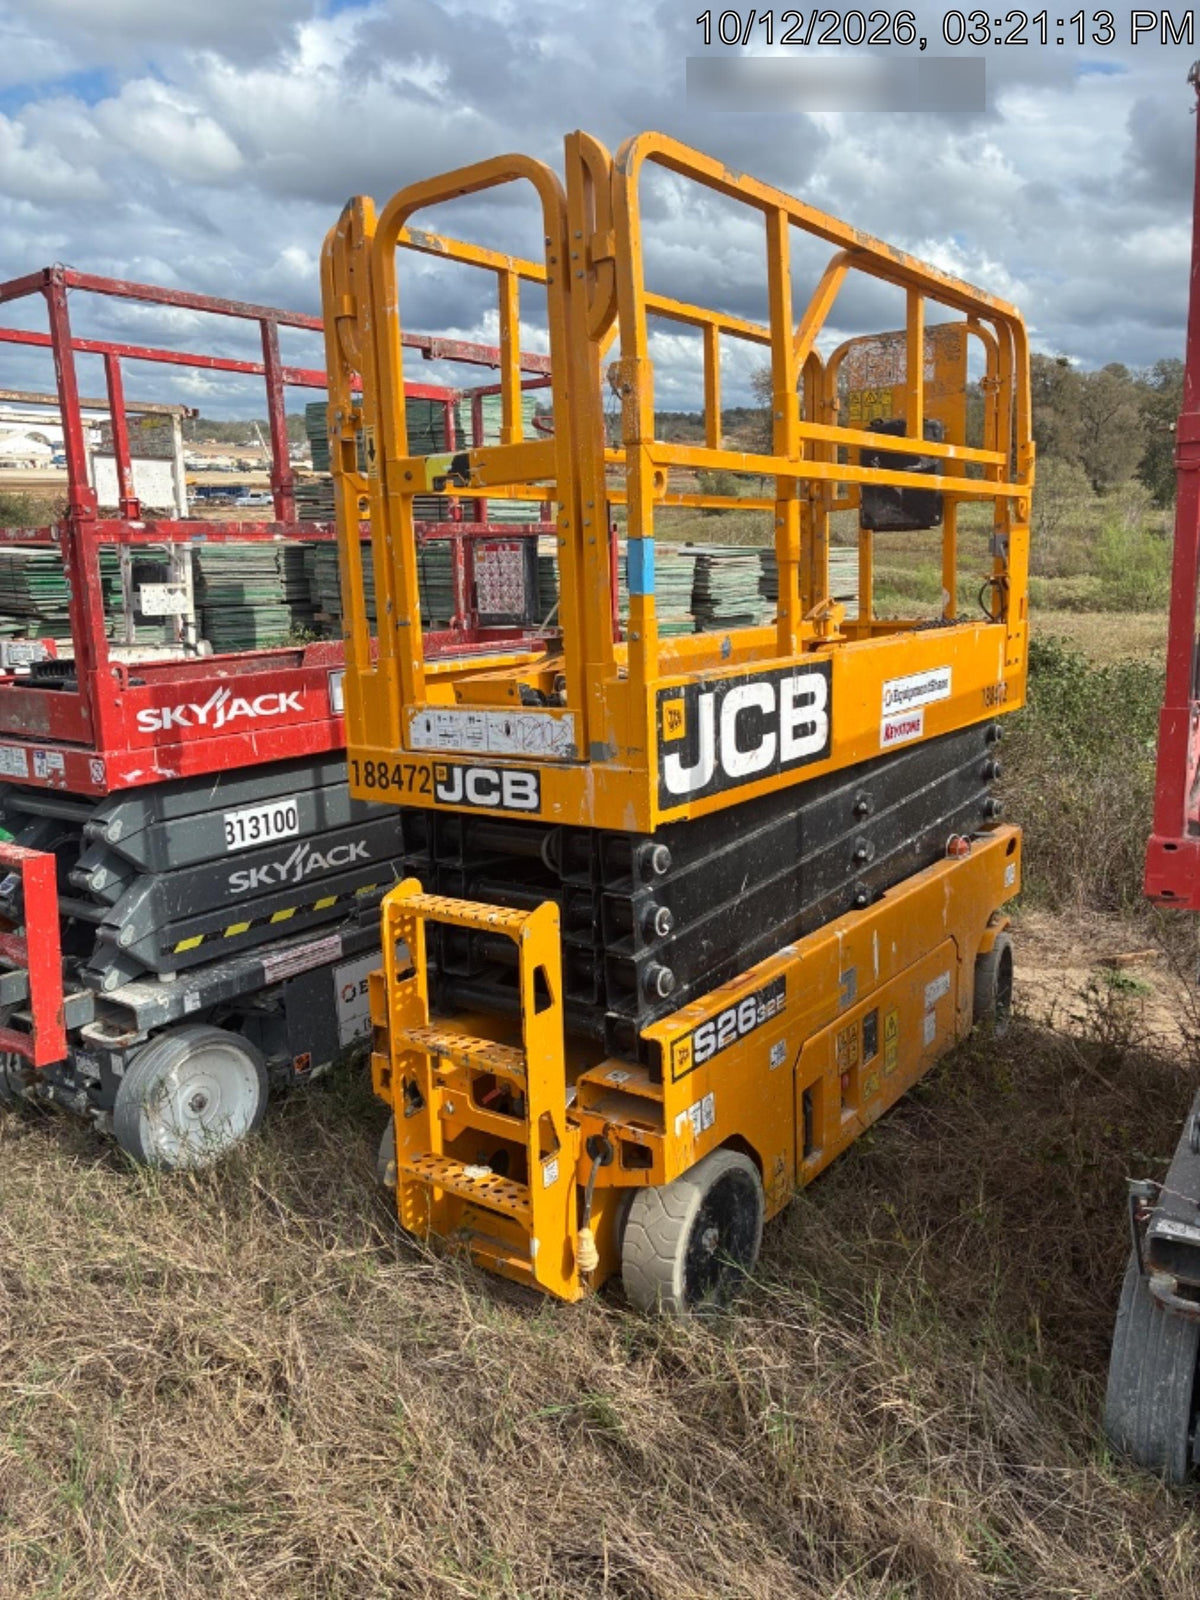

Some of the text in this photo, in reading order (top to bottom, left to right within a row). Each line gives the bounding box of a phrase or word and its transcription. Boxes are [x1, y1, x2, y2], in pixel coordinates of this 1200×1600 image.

[136, 686, 304, 732] SKYJACK
[663, 672, 829, 795] JCB
[351, 759, 431, 794] 188472
[436, 766, 540, 809] JCB
[225, 807, 297, 846] 313100
[228, 840, 372, 893] SKYJACK
